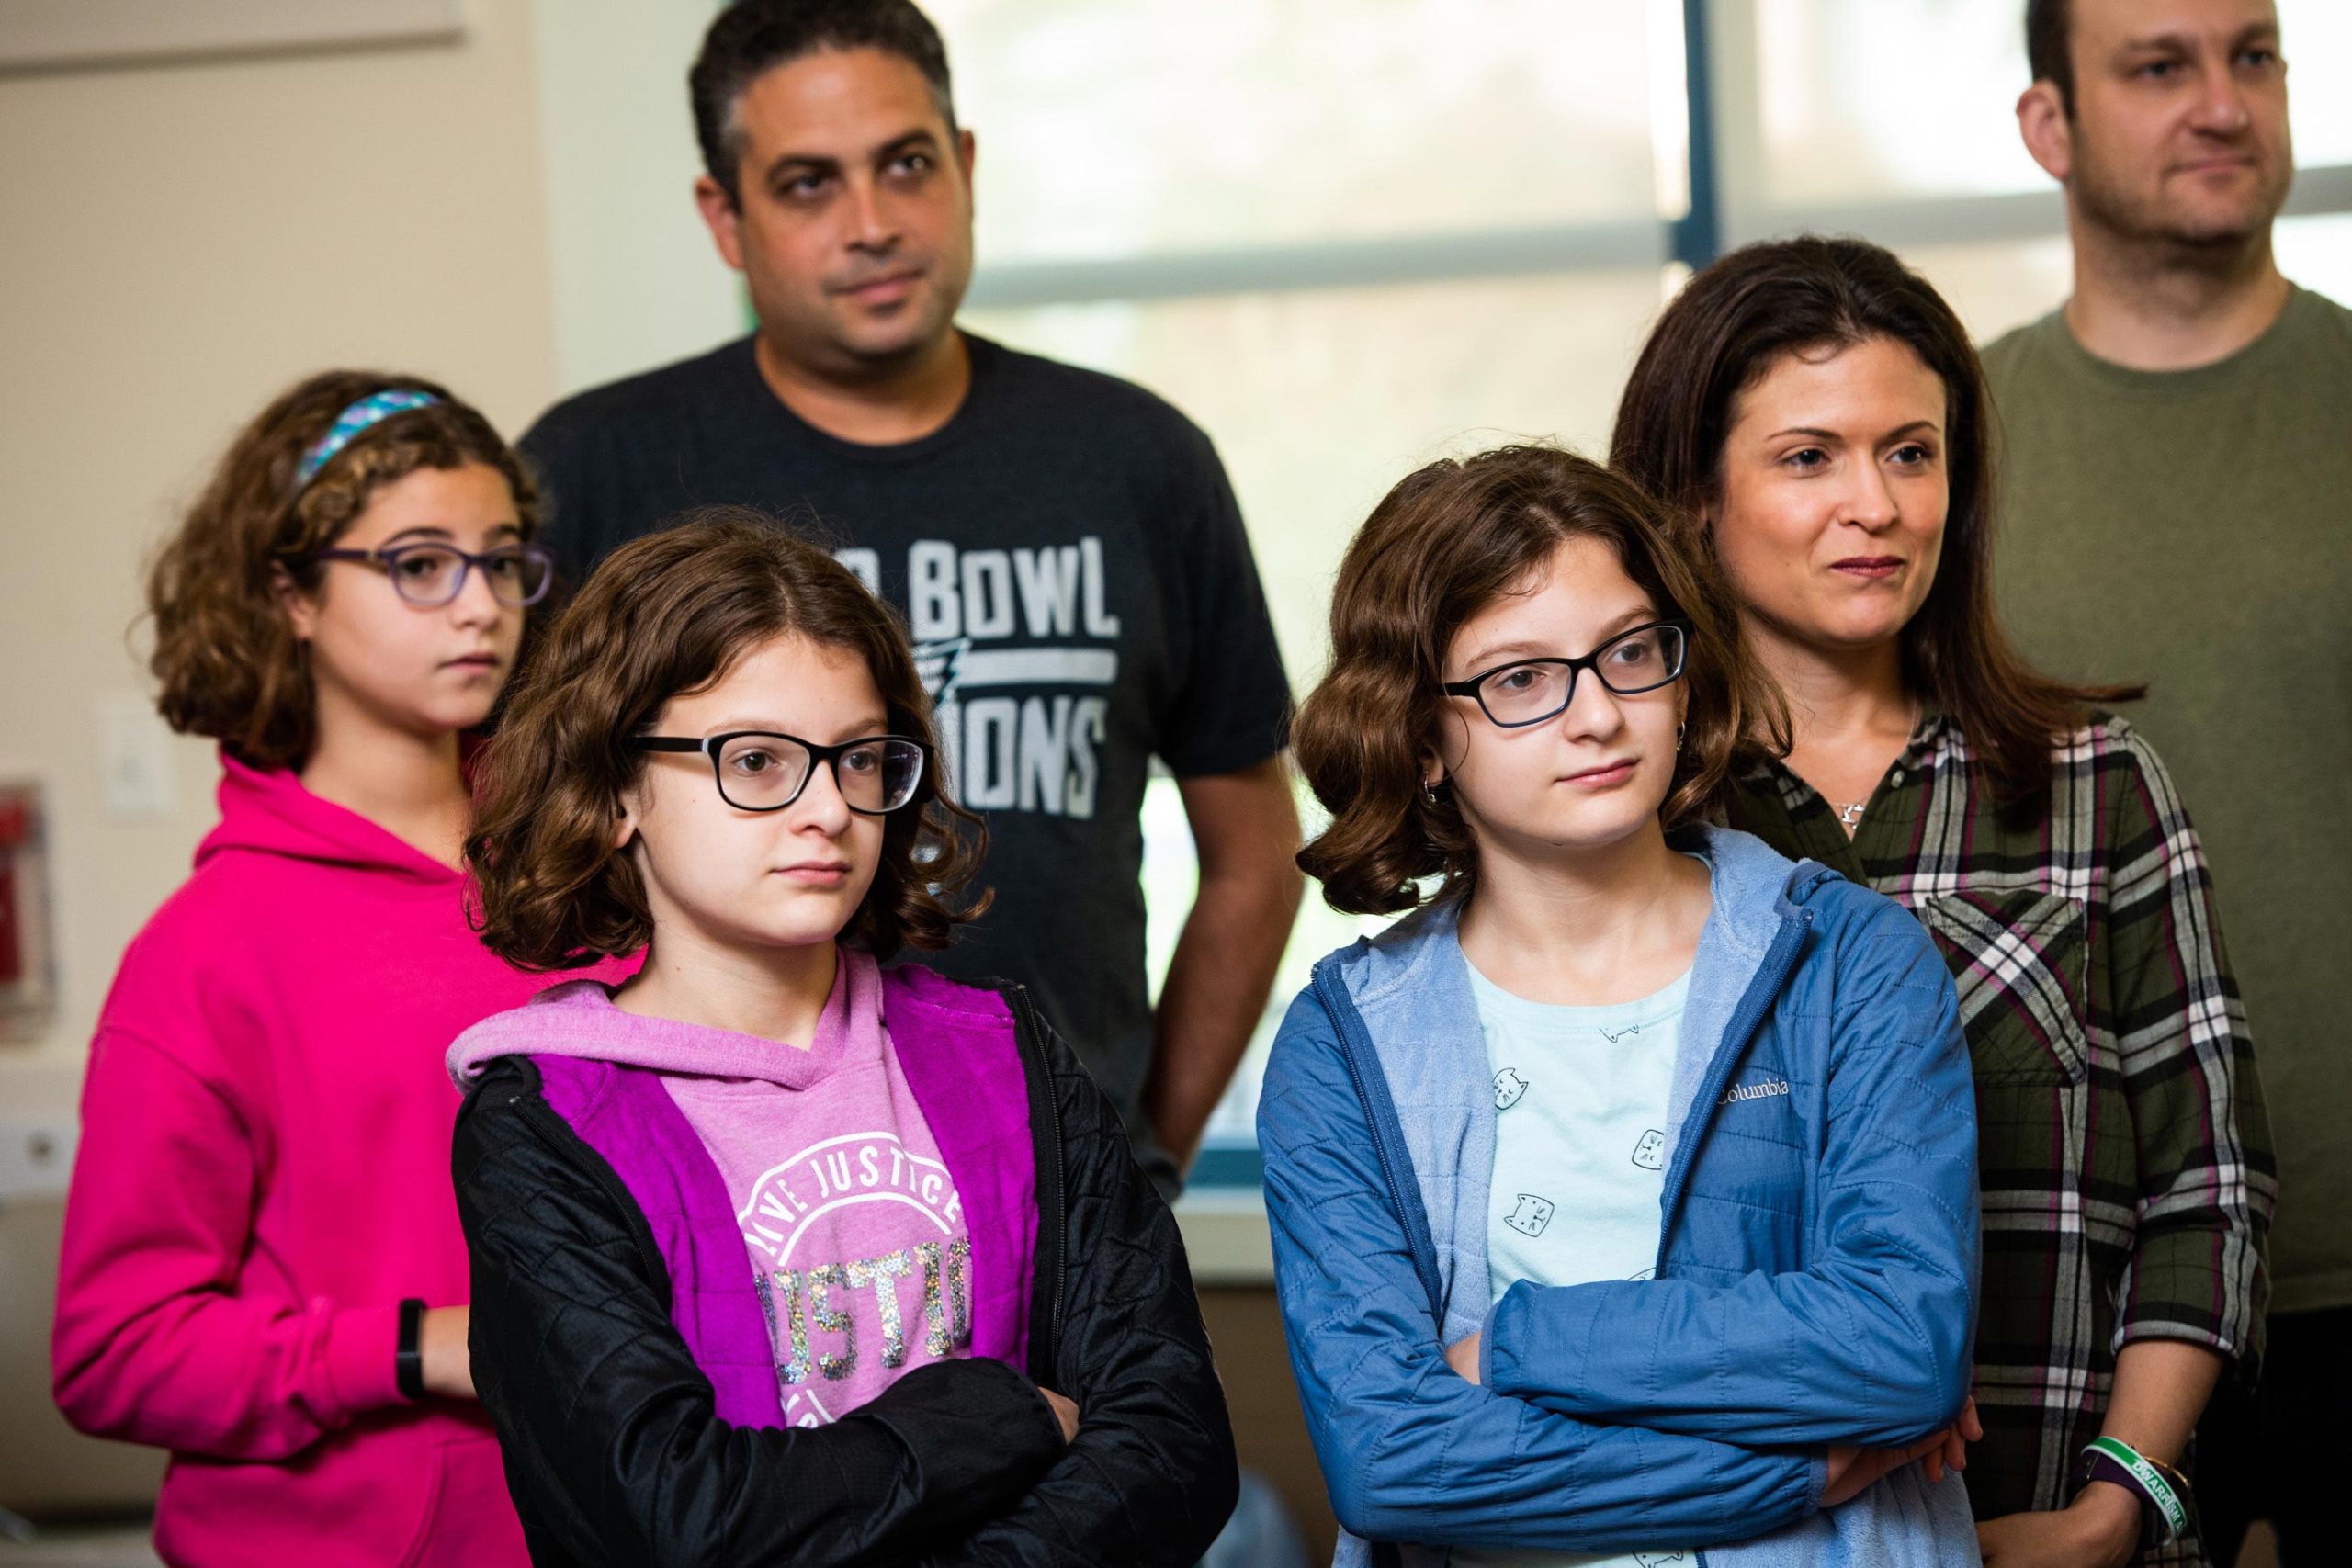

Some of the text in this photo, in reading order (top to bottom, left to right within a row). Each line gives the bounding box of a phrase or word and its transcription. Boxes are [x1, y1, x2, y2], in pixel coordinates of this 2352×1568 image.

[908, 536, 1121, 641] BOWL
[810, 1145, 961, 1224] JUSTICE
[2132, 1459, 2181, 1522] DWARFISM
